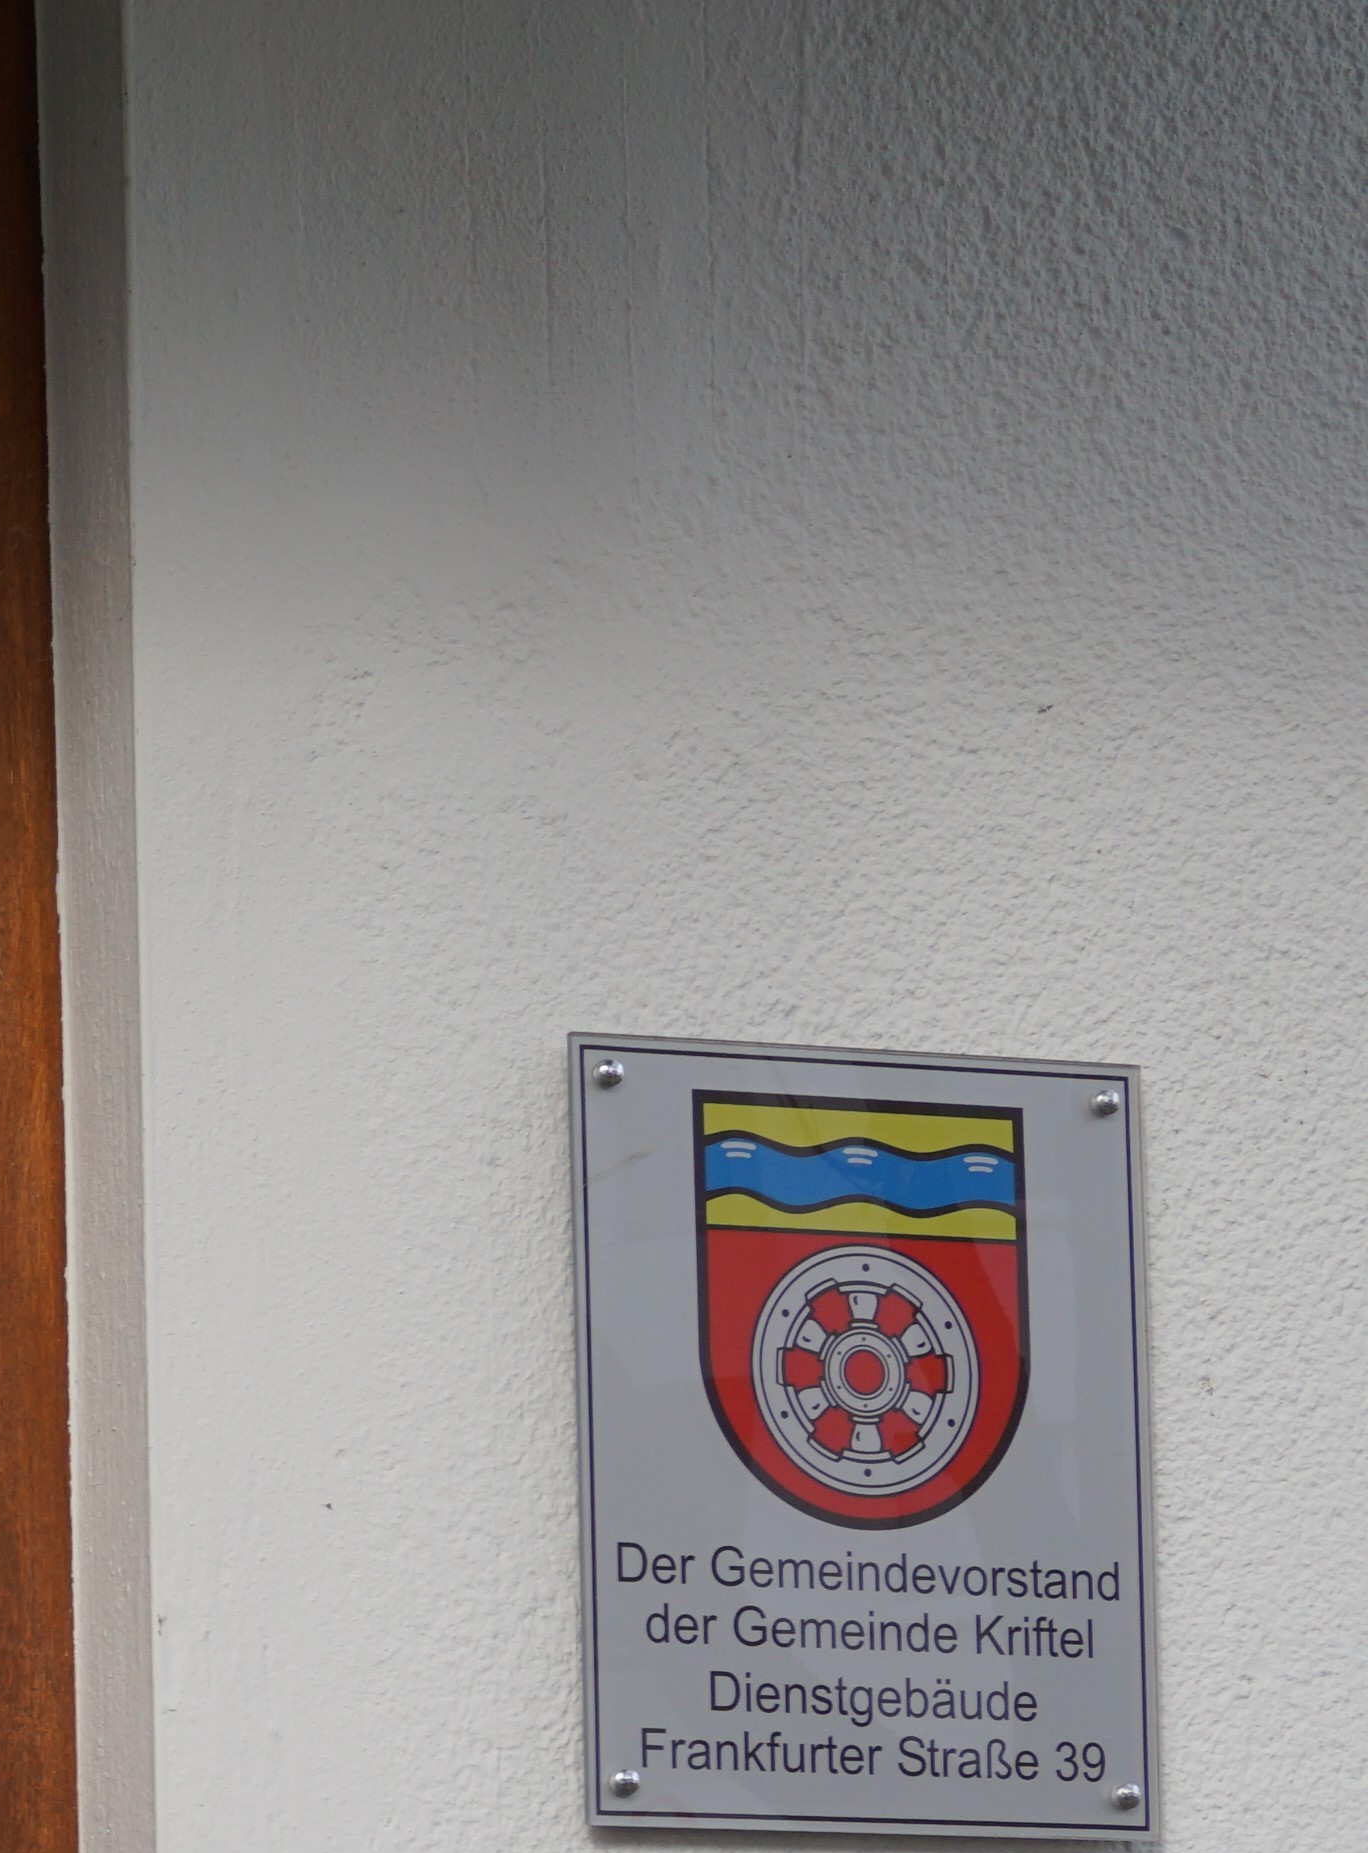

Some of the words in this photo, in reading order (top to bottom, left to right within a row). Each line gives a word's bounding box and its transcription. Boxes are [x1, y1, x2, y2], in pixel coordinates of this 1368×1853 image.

[616, 1541, 696, 1585] Der
[711, 1545, 1120, 1602] Gemeindevorstand
[645, 1602, 718, 1645] der
[733, 1605, 958, 1654] Gemeinde
[975, 1614, 1094, 1659] Kriftel
[709, 1670, 1038, 1728] Dienstgebäude
[641, 1728, 883, 1776] Frankfurter
[897, 1737, 1039, 1781] Straße
[1055, 1741, 1106, 1783] 39
